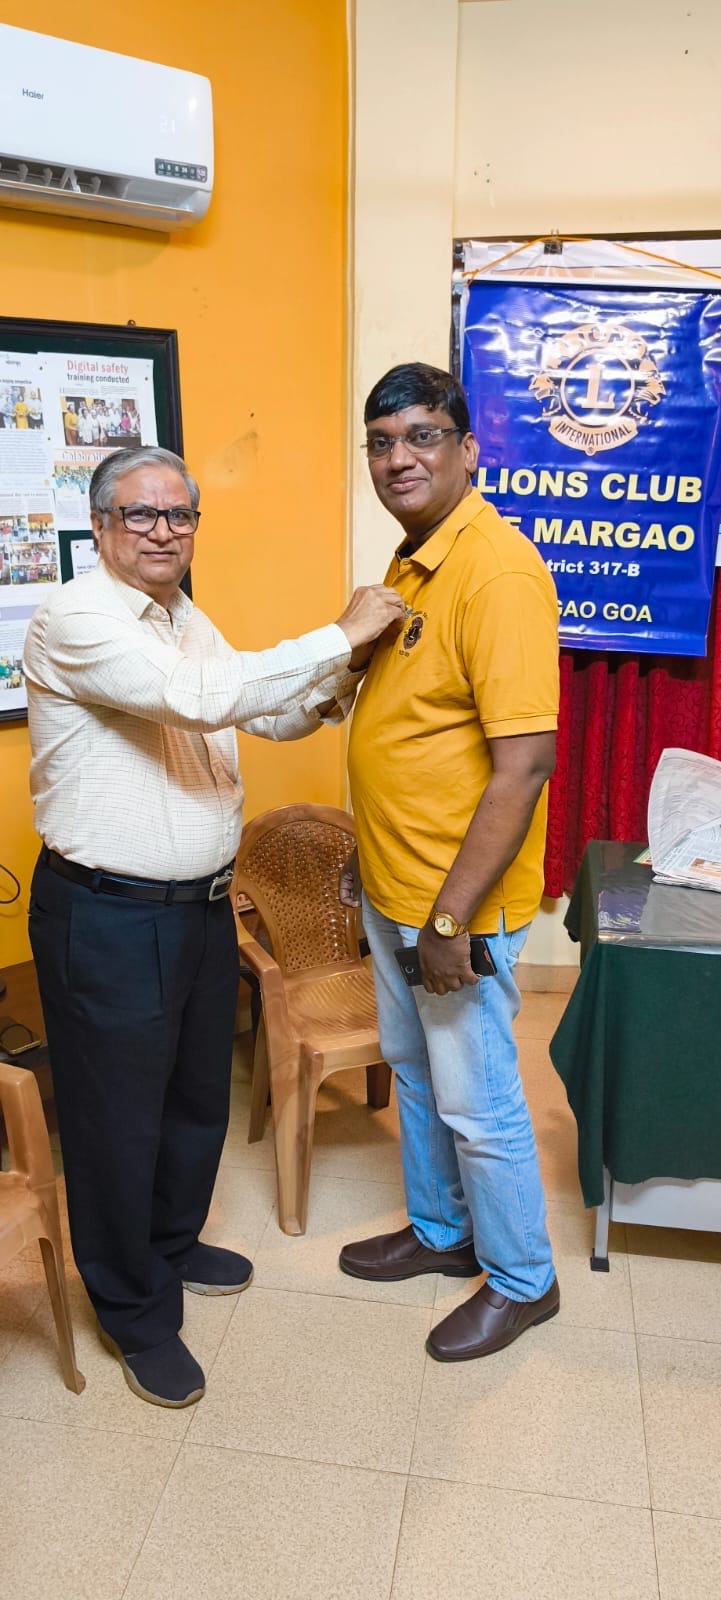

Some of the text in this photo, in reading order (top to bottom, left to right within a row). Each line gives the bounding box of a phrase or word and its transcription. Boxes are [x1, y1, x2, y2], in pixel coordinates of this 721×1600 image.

[22, 88, 44, 100] Haier
[67, 360, 129, 376] Digital safety
[67, 372, 130, 384] training conducted
[554, 420, 632, 446] INTERNATIONAL
[477, 466, 703, 503] LIONS CLUB
[533, 517, 696, 552] MARGAO
[546, 558, 641, 577] trict 317-B
[602, 602, 653, 623] GOA
